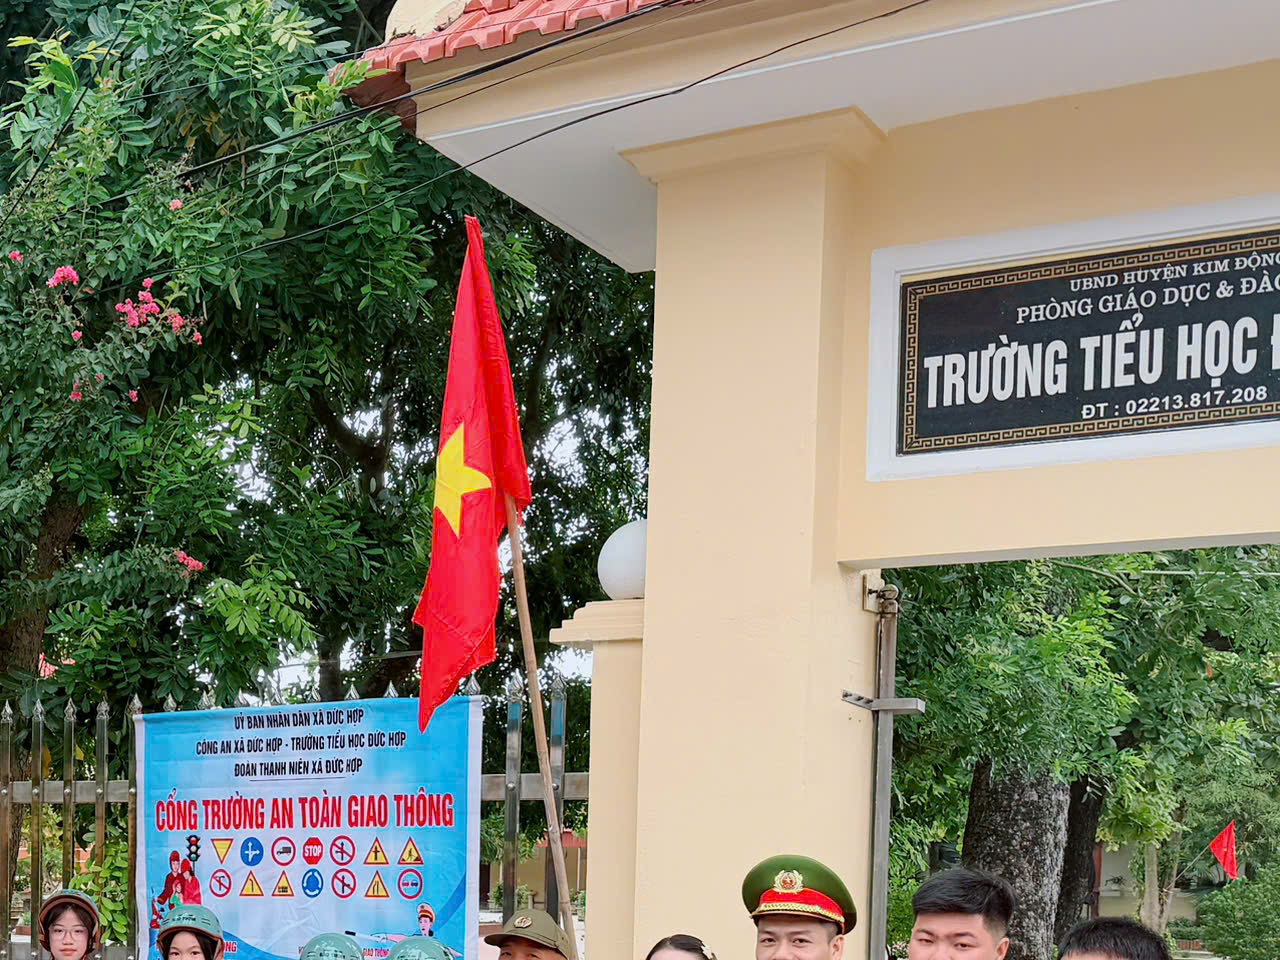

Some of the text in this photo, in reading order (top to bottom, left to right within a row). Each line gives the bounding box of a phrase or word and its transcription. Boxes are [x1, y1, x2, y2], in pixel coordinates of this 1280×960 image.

[1070, 274, 1119, 292] UBND
[1122, 264, 1188, 285] HUYỆN
[1192, 259, 1230, 276] KIM
[1016, 297, 1093, 324] PHÒNG
[1098, 287, 1157, 313] GIÁO
[1162, 283, 1210, 307] DỤC
[1216, 280, 1234, 298] &
[923, 334, 1068, 409] TRƯỜNG
[1080, 313, 1164, 391] TIỂU
[1176, 316, 1258, 388] HỌC
[1081, 403, 1110, 420] ĐT
[1126, 385, 1268, 415] 02213.817.208
[247, 715, 265, 729] BAN
[267, 713, 290, 728] NHÂN
[292, 712, 311, 727] DÂN
[313, 712, 324, 726] XÃ
[326, 709, 345, 725] ĐỨC
[347, 709, 364, 728] HỢP
[196, 739, 218, 755] CÔNG
[220, 740, 231, 754] AN
[234, 737, 245, 753] XÃ
[247, 737, 264, 752] ĐỨC
[266, 737, 283, 755] HỢP
[291, 734, 325, 751] TRƯỜNG
[327, 729, 345, 749] TIỂU
[348, 734, 365, 752] HỌC
[368, 730, 386, 747] ĐỨC
[388, 731, 406, 751] HỢP
[234, 756, 363, 777] ĐOÀN THANH NIÊN XÃ ĐỨC HỢP
[156, 786, 455, 831] CỔNG TRƯỜNG AN TOÀN GIAO THÔNG
[304, 845, 322, 857] STOP
